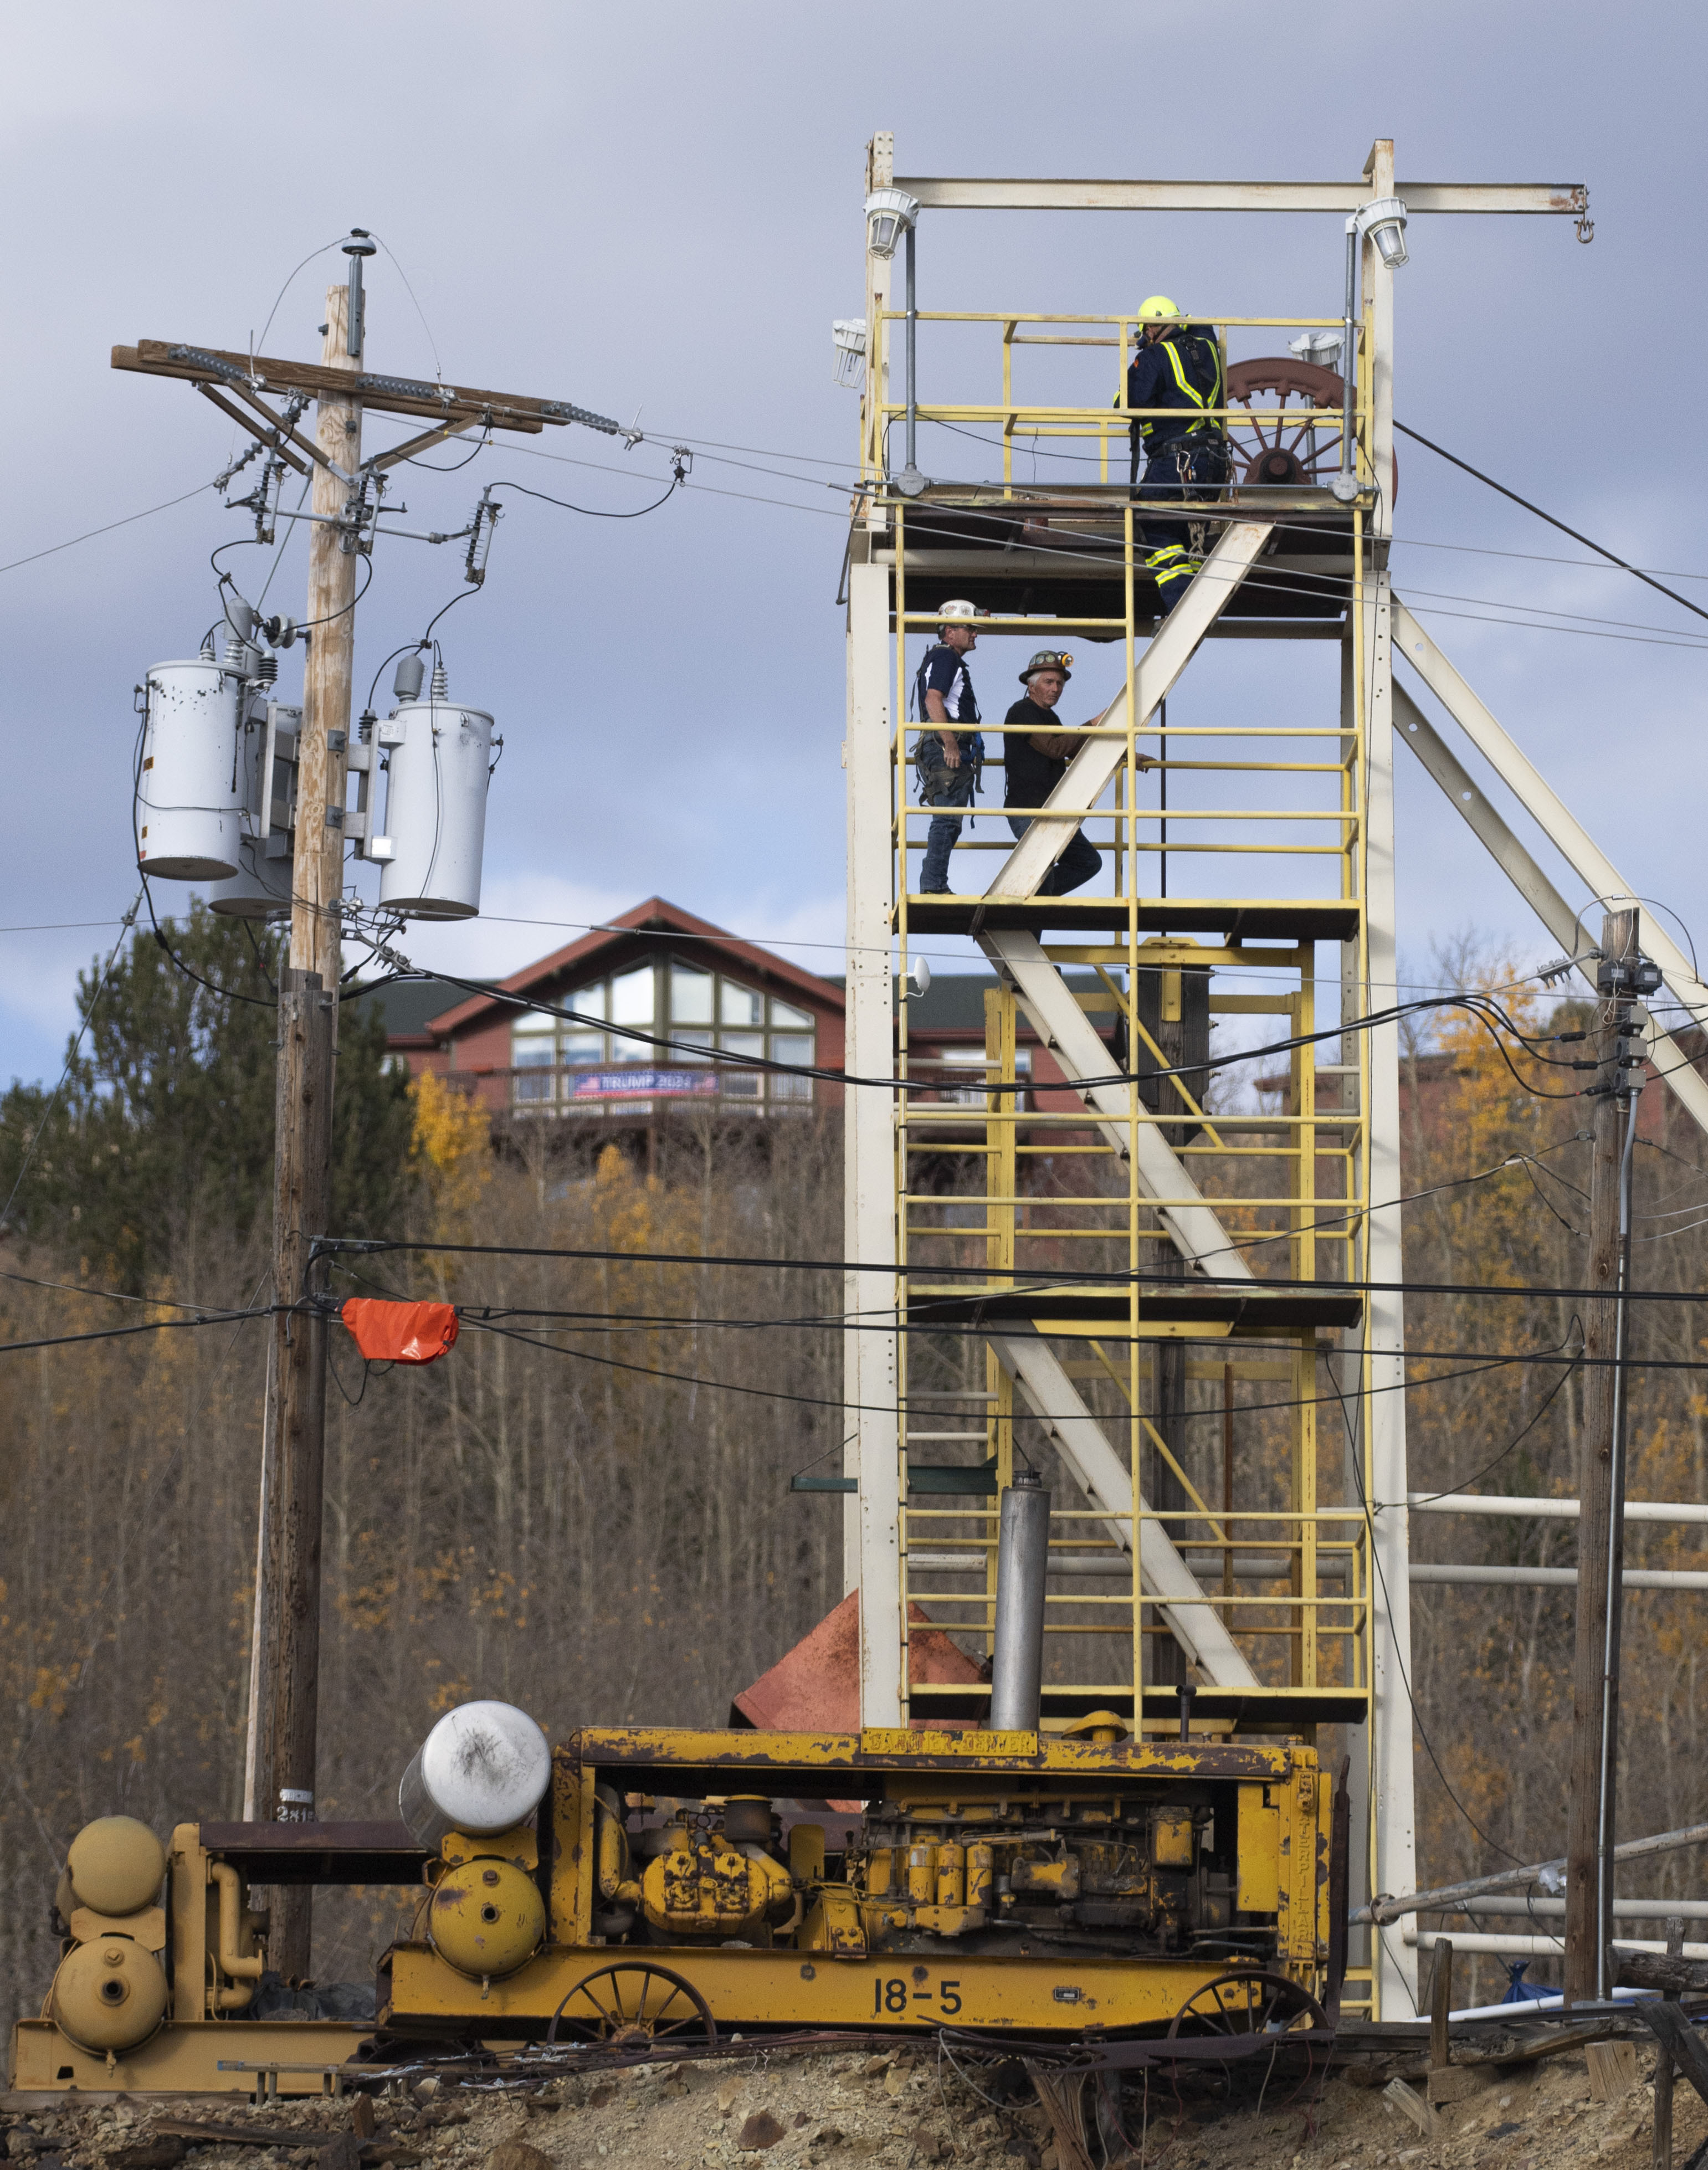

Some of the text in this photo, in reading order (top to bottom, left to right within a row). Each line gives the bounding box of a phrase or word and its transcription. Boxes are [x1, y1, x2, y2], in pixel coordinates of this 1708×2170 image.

[601, 1075, 654, 1089] TRUMP
[1297, 1809, 1311, 1942] ATERPILLAR
[875, 1978, 962, 2015] 18-5
